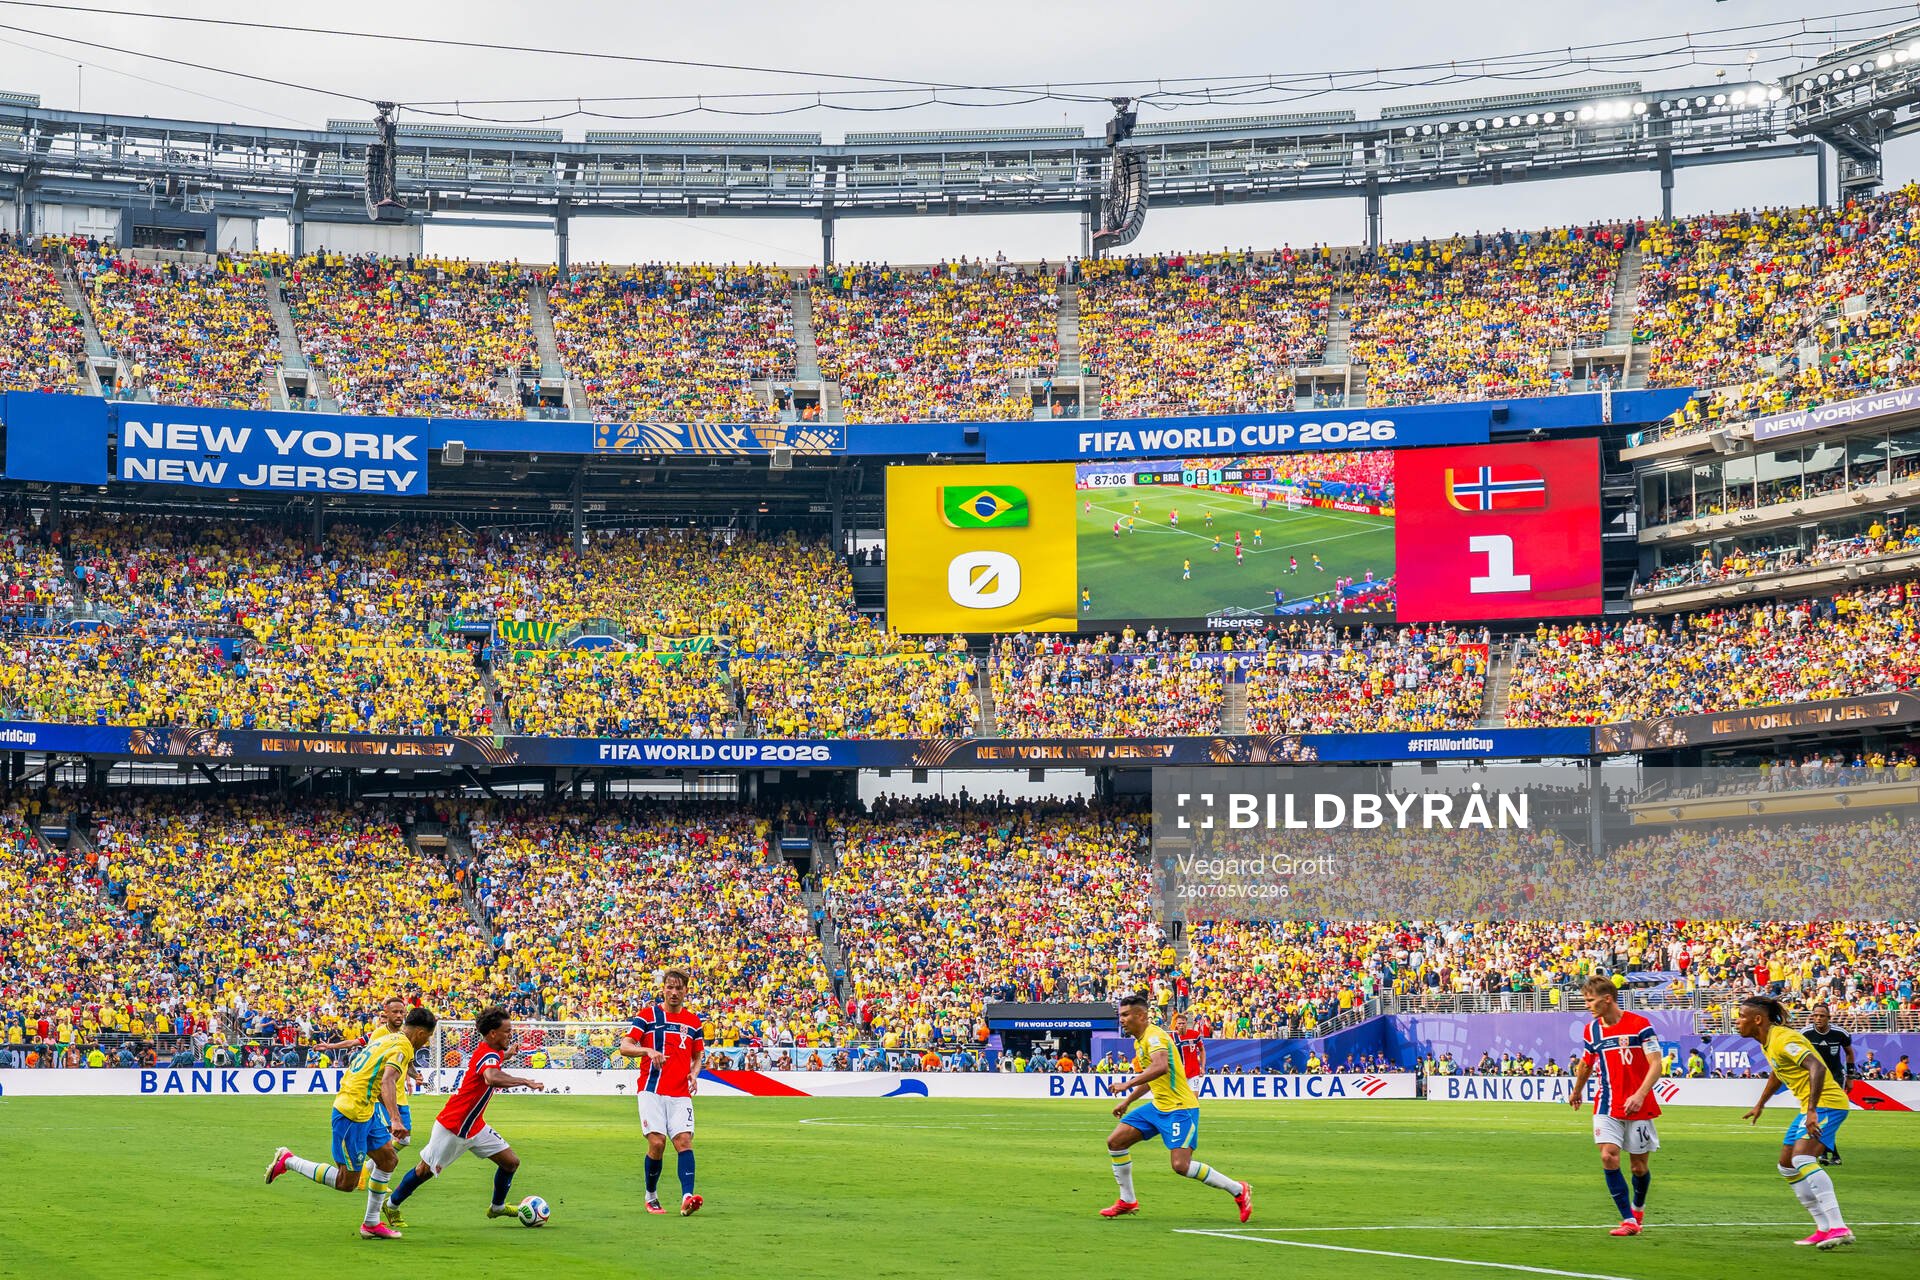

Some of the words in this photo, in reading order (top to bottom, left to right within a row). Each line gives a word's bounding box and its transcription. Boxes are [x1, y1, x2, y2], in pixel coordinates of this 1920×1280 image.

[1765, 414, 1807, 433] NEW
[1811, 402, 1865, 423] YORK
[1868, 392, 1913, 413] NEW
[124, 421, 252, 453] NEW
[264, 428, 418, 461] YORK
[1079, 431, 1135, 453] FIFA
[1137, 427, 1237, 450] WORLD
[1240, 424, 1295, 447] CUP
[1299, 420, 1396, 443] 2026
[124, 457, 228, 484] NEW
[238, 464, 418, 492] JERSEY
[1094, 475, 1127, 485] 87:06
[1162, 473, 1180, 483] BRA
[1186, 473, 1192, 482] 0
[1225, 471, 1242, 480] NOR
[1334, 502, 1370, 514] McDonald's
[1469, 535, 1531, 593] 1
[948, 551, 1021, 609] 0
[1206, 617, 1264, 629] Hisense
[1712, 718, 1747, 735] NEW
[1750, 713, 1792, 730] YORK
[1795, 708, 1832, 726] NEW
[1835, 700, 1900, 722] JERSEY
[261, 738, 300, 752] NEW
[303, 739, 347, 754] YORK
[350, 740, 387, 755] NEW
[390, 742, 455, 757] JERSEY
[600, 744, 641, 760] FIFA
[643, 744, 715, 760] WORLD
[718, 744, 759, 760] CUP
[761, 745, 830, 760] 2026
[977, 746, 1015, 759] NEW
[1018, 746, 1063, 759] YORK
[1067, 745, 1105, 759] NEW
[1108, 744, 1174, 758] JERSEY
[1408, 737, 1494, 753] #FIFAWorldCup
[1618, 1048, 1634, 1065] 10
[1715, 1051, 1751, 1069] FIFA
[140, 1070, 240, 1093] BANK
[253, 1070, 295, 1093] OF
[1050, 1075, 1136, 1097] BANK
[1199, 1075, 1346, 1099] AMERICA
[1448, 1078, 1510, 1101] BANK
[1521, 1079, 1548, 1101] OF
[1172, 1122, 1181, 1136] 5
